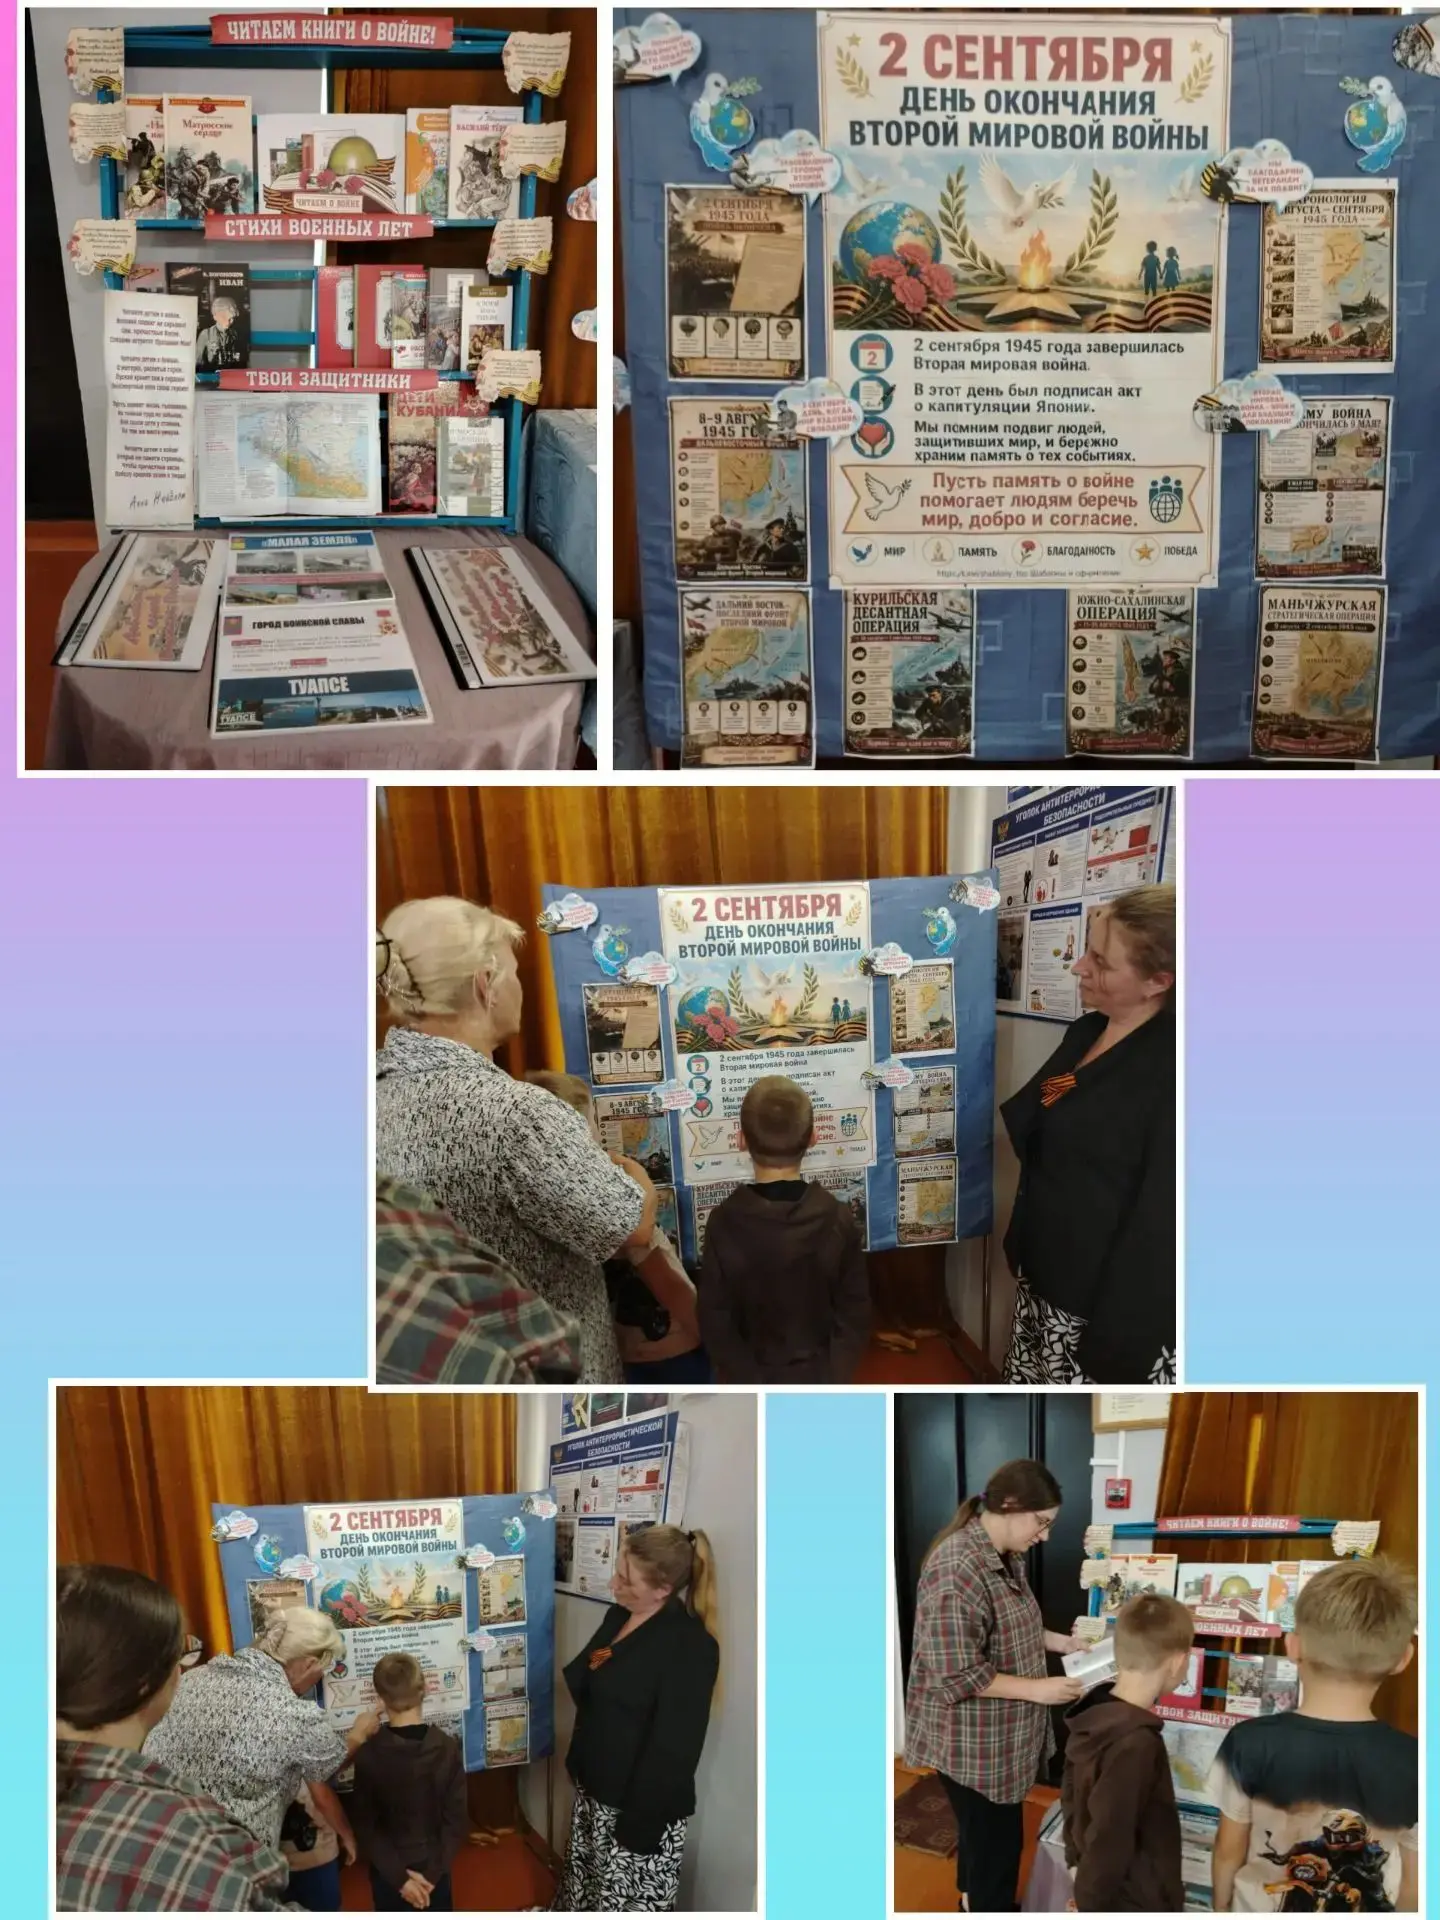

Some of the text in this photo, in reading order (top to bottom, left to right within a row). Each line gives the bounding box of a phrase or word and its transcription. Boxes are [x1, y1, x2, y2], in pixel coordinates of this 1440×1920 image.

[227, 20, 436, 45] ЧИТАЕМ КНИГИ О ВОЙНЕ!
[879, 32, 1173, 82] 2 СЕНТЯБРЯ
[899, 87, 1156, 116] ДЕНЬ ОКОНЧАНИЯ
[849, 116, 1209, 150] ВТОРОЙ МИРОВОЙ ВОЙНЫ
[296, 198, 360, 208] ЧИТАЕМ О ВОЙНЕ
[1281, 205, 1385, 214] ВГУСТА СЕНТЯБРЯ
[709, 210, 735, 221] 1945
[1331, 215, 1358, 224] ГОДА
[225, 219, 414, 238] СТИХИ ВОЕННЫХ ЛЕТ
[914, 338, 1185, 356] 2 сентября 1945 года завершилась
[867, 351, 878, 366] 2
[914, 357, 965, 374] Вторая
[970, 360, 1037, 374] мировая
[247, 372, 412, 389] ТВОИ ЗАЩИТНИКИ
[914, 382, 1143, 401] В этот день был подписан акт
[397, 405, 455, 417] КУБАНИ
[914, 402, 923, 413] о
[928, 401, 1030, 416] капитуляции
[1332, 407, 1372, 419] ВОЙНА
[703, 426, 736, 438] 1945
[914, 421, 1106, 437] Мы помним подвиг людей,
[914, 434, 1118, 451] защитивших мир, и бережно
[914, 448, 1136, 464] храним память о тех событиях.
[933, 471, 1134, 491] Пусть память о войне
[920, 490, 1138, 511] помогает людям беречь
[922, 512, 1138, 530] мир, добро и согласие.
[884, 546, 906, 557] МИР
[958, 547, 998, 558] ПАМЯТЬ
[1164, 546, 1198, 557] ПОБЕДА
[853, 591, 938, 606] КУРИЛЬСКАЯ
[1077, 594, 1186, 606] ЮЖНО-САХАЛИНСКАЯ
[1268, 598, 1376, 611] МАНЬЧЖУРСКАЯ
[853, 606, 928, 620] ДЕСАНТНАЯ
[1076, 606, 1157, 621] ОПЕРАЦИЯ
[1267, 611, 1376, 621] СТРАТЕГИЧЕСКАЯ ОПЕРАЦИЯ
[252, 616, 365, 630] ГОРОД ВОИНСКОЙ СЛАВЫ
[853, 620, 920, 634] ОПЕРАЦИЯ
[288, 676, 350, 695] ТУАПСЕ
[1015, 804, 1041, 824] УГОЛОК
[1043, 792, 1106, 826] БЕЗОПАСНОСТИ
[692, 893, 842, 922] 2 СЕНТЯБРЯ
[705, 921, 835, 942] ДЕНЬ ОКОНЧАНИЯ
[678, 935, 862, 959] ВТОРОЙ МИРОВОЙ ВОЙНЫ
[719, 1047, 855, 1063] 2 сентября 1945 года завершилась
[720, 1063, 747, 1073] Вторая
[749, 1061, 782, 1071] мировая
[823, 1069, 836, 1077] акт
[586, 1419, 664, 1448] АНТИТЕРРОРИСТИЧЕСКОЙ
[330, 1507, 443, 1532] 2 СЕНТЯБРЯ
[1166, 1517, 1290, 1530] ЧИТАЕМ КНИГИ О ВОЙНЕ!
[340, 1529, 437, 1546] ДЕНЬ ОКОНЧАНИЯ
[320, 1539, 457, 1559] ВТОРОЙ МИРОВОЙ ВОЙНЫ
[1244, 1625, 1269, 1637] ЛЕТ
[1155, 1705, 1184, 1718] ТВОИ
